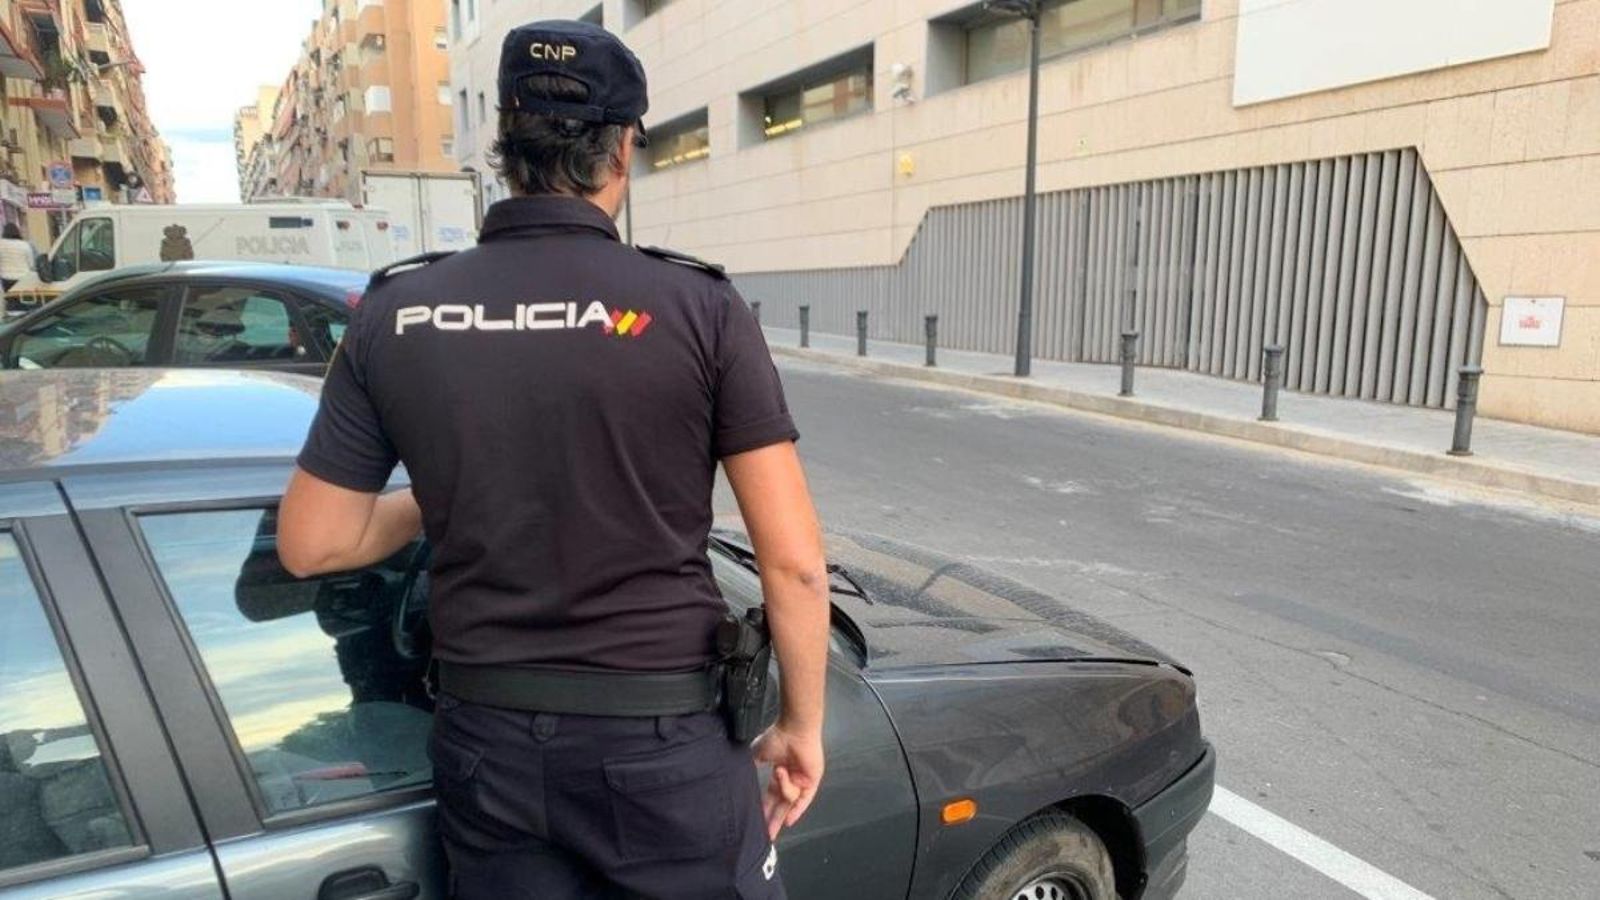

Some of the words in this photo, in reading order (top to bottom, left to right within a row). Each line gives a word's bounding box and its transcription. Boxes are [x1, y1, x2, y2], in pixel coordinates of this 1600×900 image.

[529, 42, 577, 60] CNP
[236, 235, 310, 255] POLICIA
[395, 300, 614, 335] POLICIA
